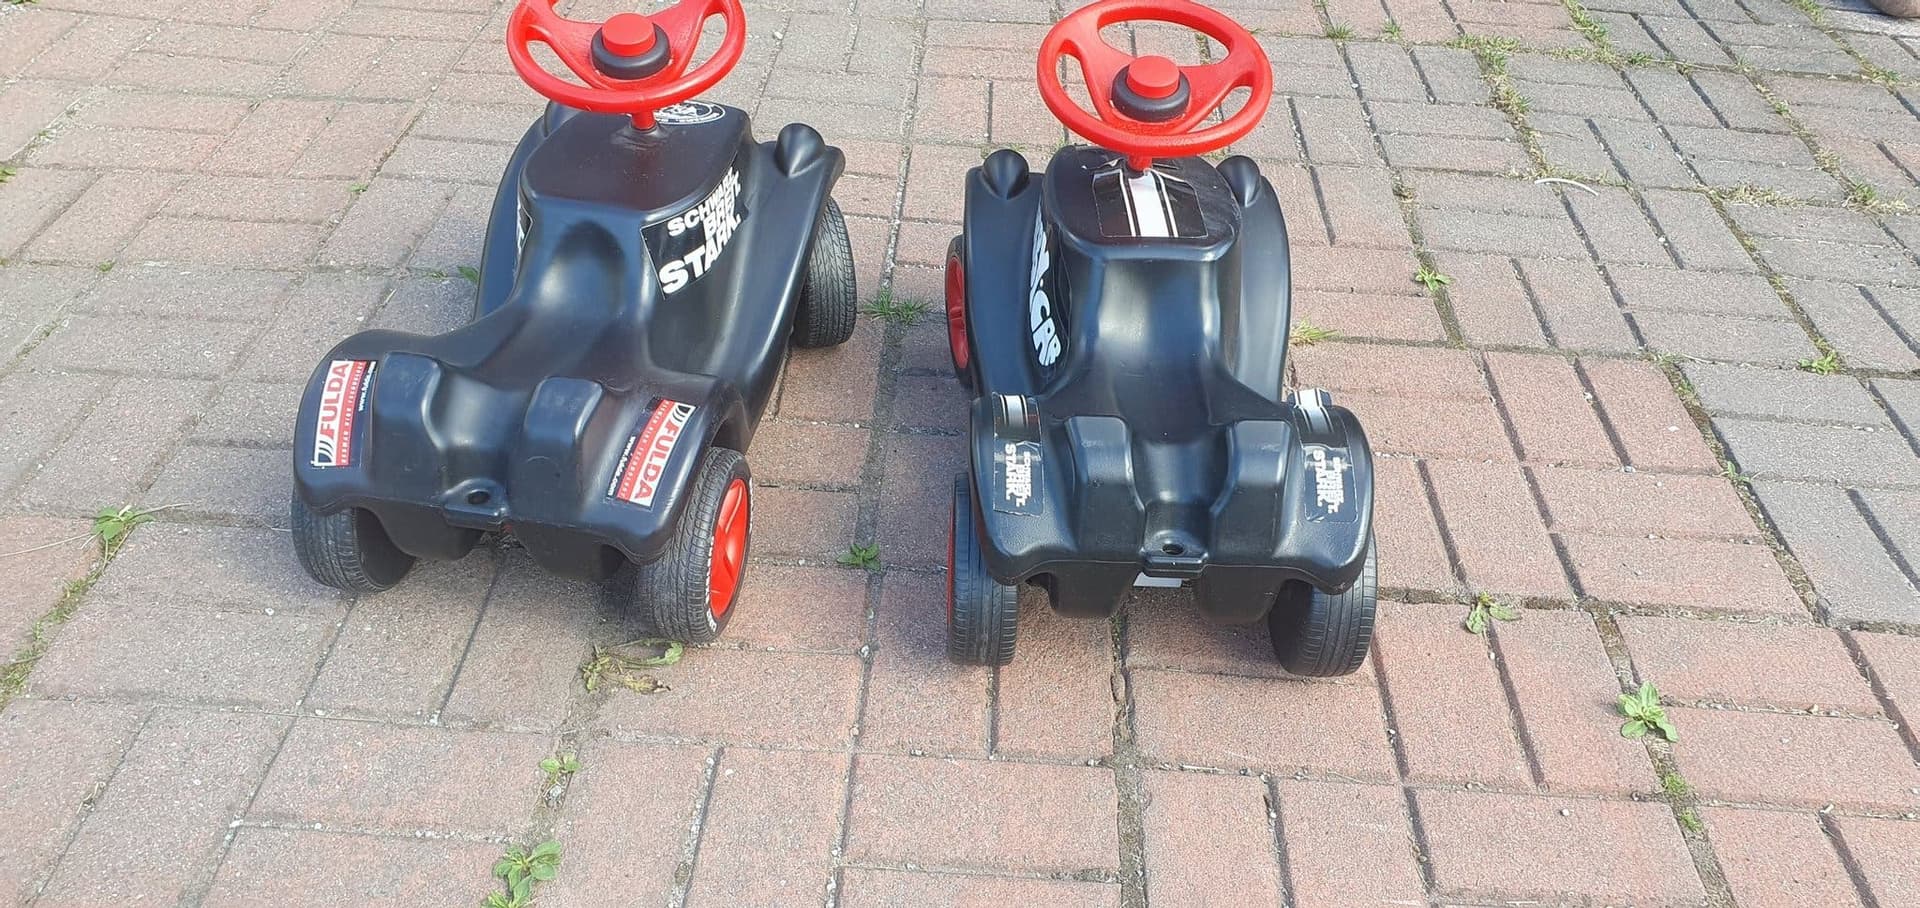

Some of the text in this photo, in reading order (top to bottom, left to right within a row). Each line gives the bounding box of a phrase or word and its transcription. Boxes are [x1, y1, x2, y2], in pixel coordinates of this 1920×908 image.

[658, 214, 741, 295] STARK.
[319, 363, 350, 440] FULDA
[634, 421, 679, 500] FULDA
